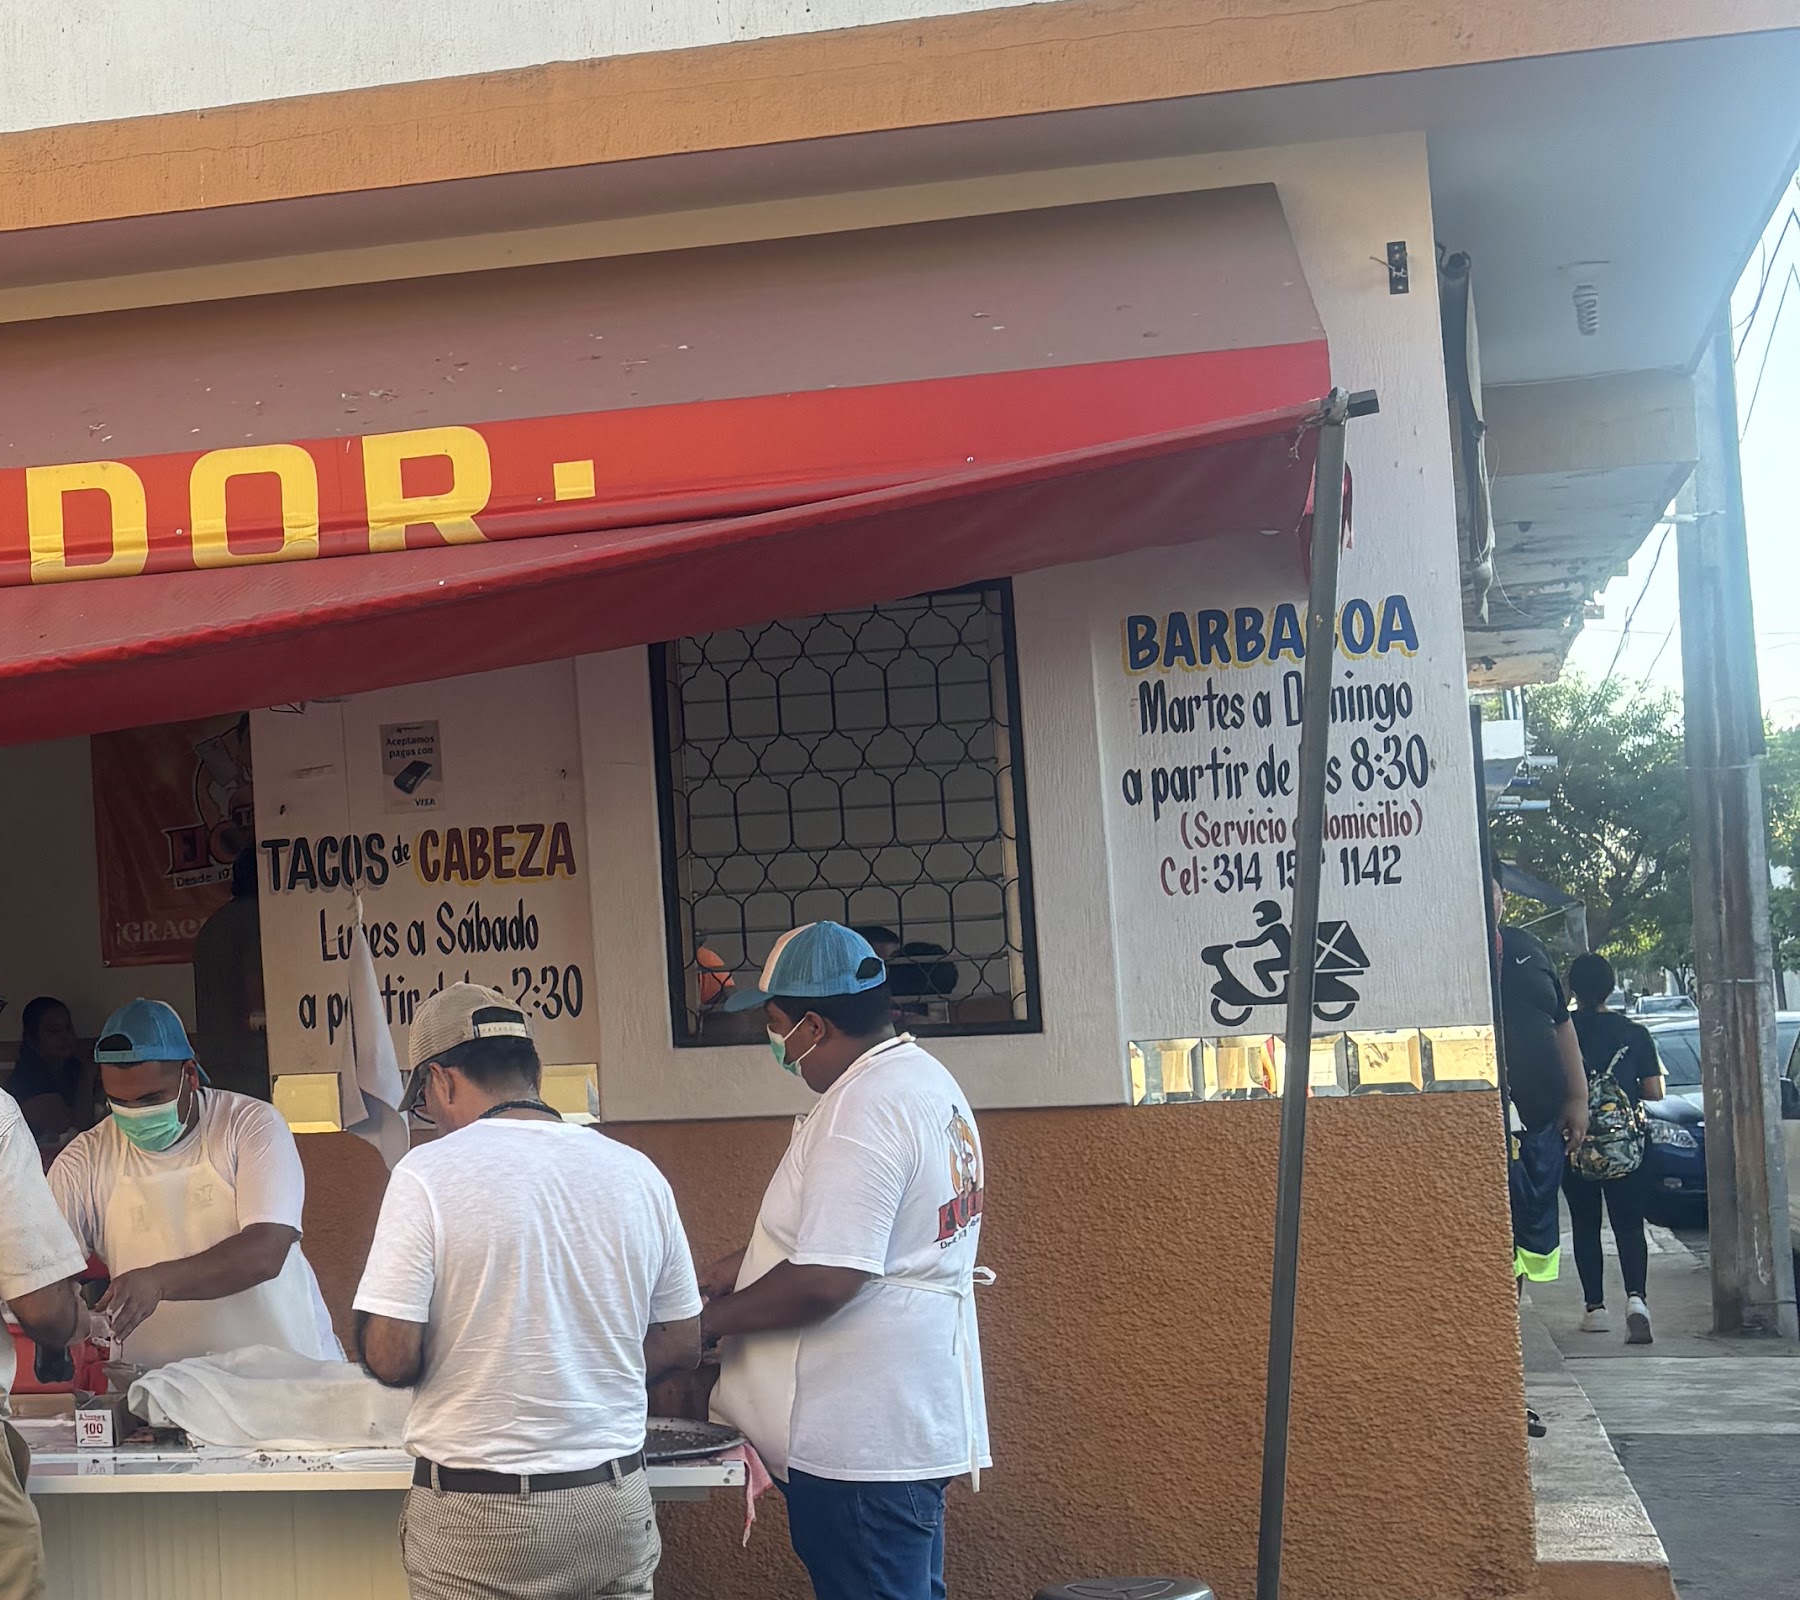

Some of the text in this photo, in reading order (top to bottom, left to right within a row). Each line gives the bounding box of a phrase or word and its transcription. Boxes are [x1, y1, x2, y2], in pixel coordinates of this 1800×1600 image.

[1122, 594, 1420, 675] BARBAOA
[1138, 670, 1413, 736] Martes a Dmingo
[1121, 768, 1143, 806] a
[1151, 746, 1249, 823] partir
[1256, 743, 1295, 799] de
[1350, 733, 1429, 792] 8:30
[260, 832, 390, 892] TACOS
[391, 834, 412, 867] de
[416, 822, 578, 885] CABEZA
[1180, 806, 1288, 850] (Servicio
[1213, 852, 1263, 894] 314
[1276, 849, 1325, 890] 15
[1340, 844, 1402, 887] 1142
[406, 919, 426, 957] a
[436, 898, 539, 955] Sábado
[298, 992, 317, 1030] a
[327, 973, 421, 1046] ptir
[511, 964, 584, 1021] 2:30
[83, 1422, 104, 1435] 100
